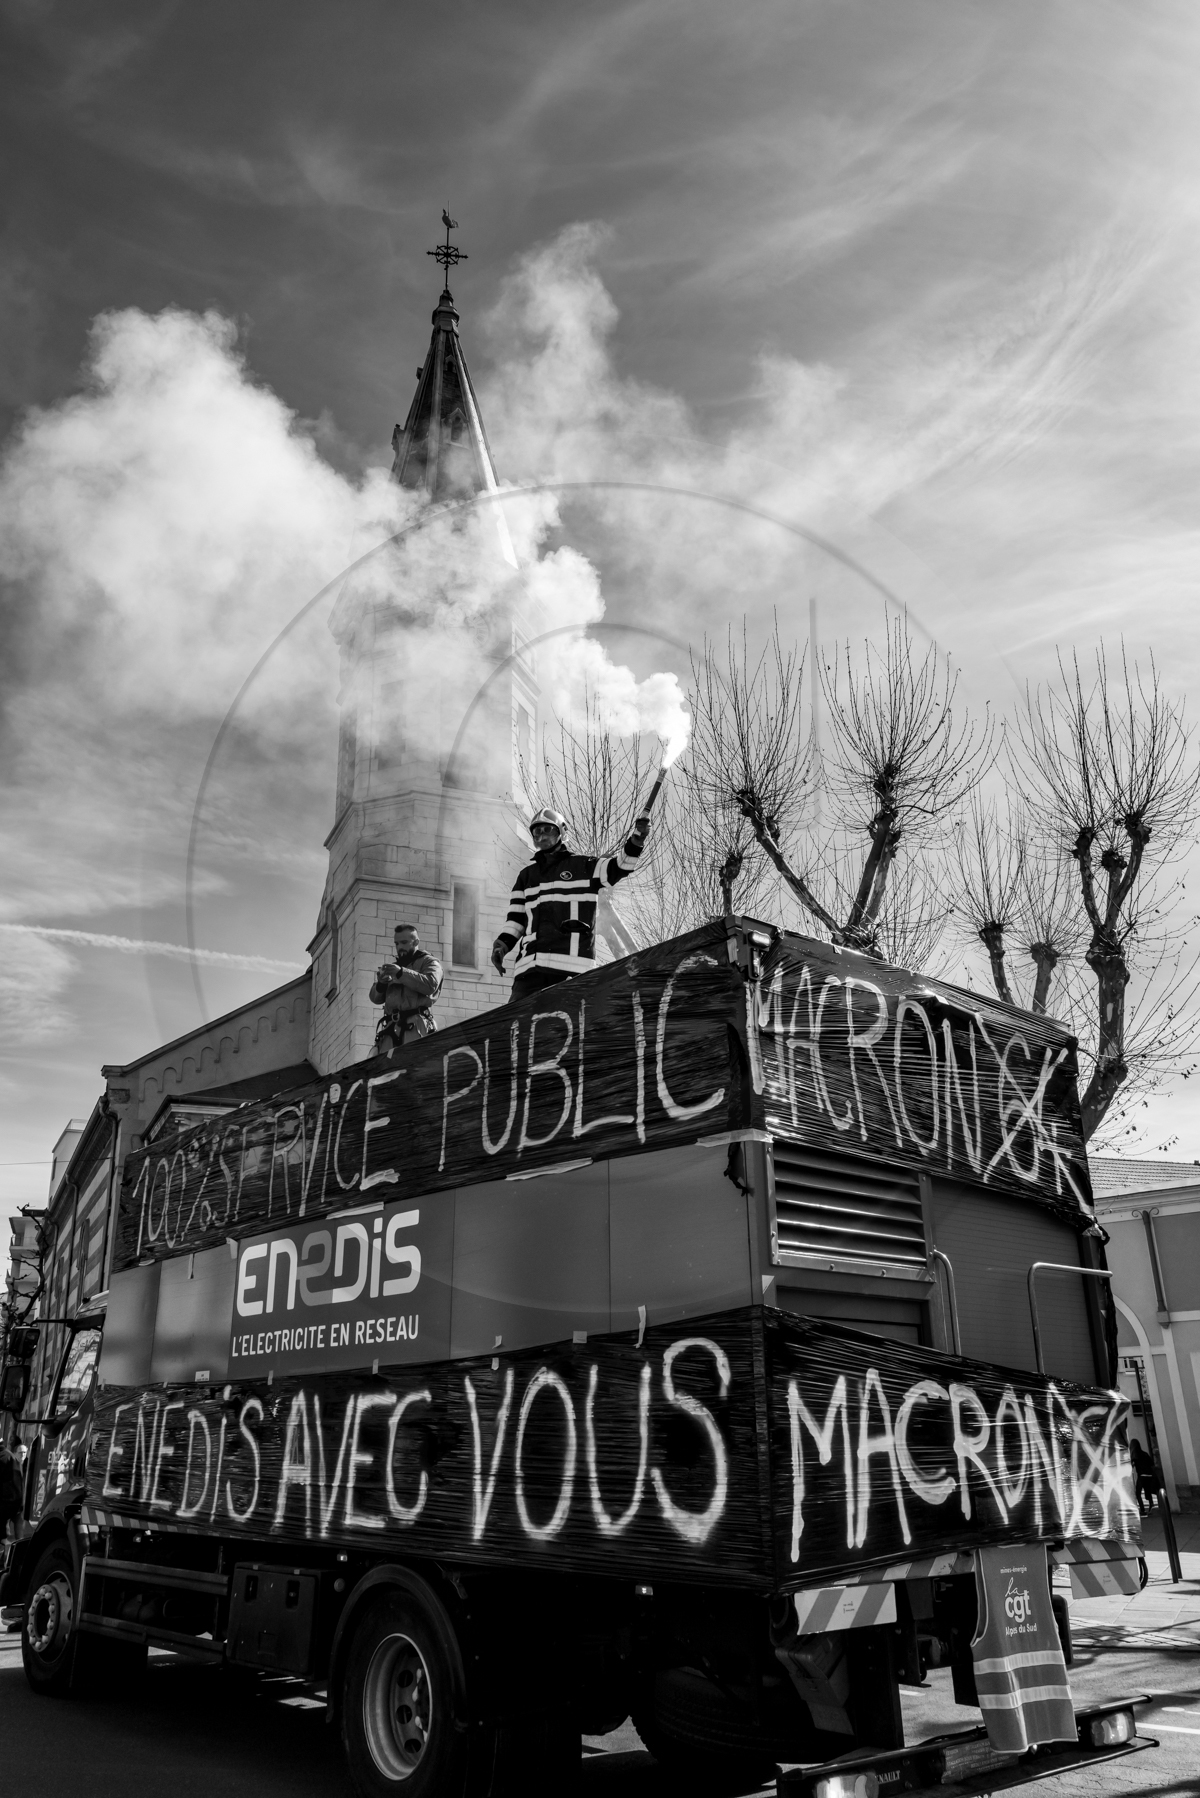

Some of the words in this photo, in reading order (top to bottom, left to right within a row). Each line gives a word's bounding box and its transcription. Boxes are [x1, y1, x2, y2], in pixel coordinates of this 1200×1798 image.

[436, 952, 726, 1172] PUBLIC
[745, 960, 984, 1175] MACRON
[232, 1325, 326, 1357] L'ELECTRICITE
[330, 1322, 350, 1347] EN
[355, 1314, 419, 1344] RESEAU
[271, 1389, 431, 1538] AVEC
[465, 1337, 731, 1543] VOUS
[787, 1368, 1066, 1563] MACRON
[1005, 1577, 1025, 1597] la
[1005, 1590, 1032, 1623] cgt
[1005, 1626, 1018, 1637] Alpes
[1018, 1624, 1026, 1634] du
[1026, 1623, 1038, 1632] Sud
